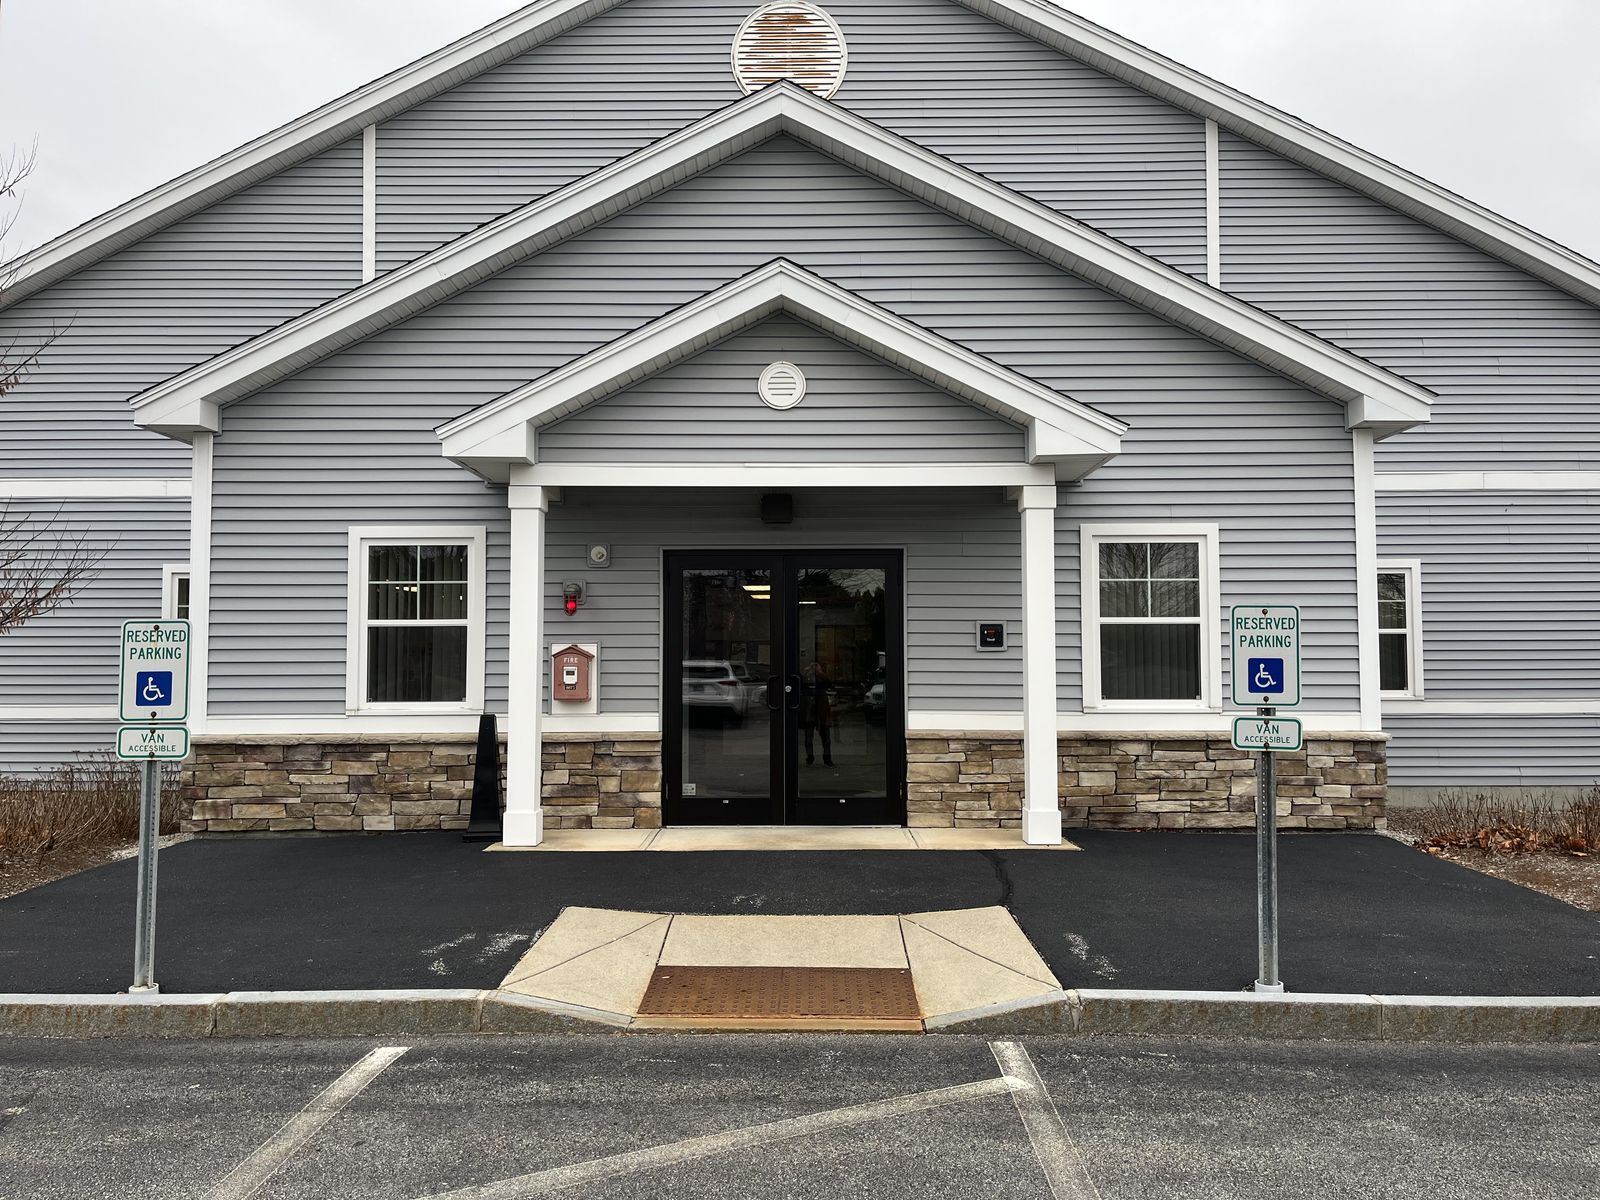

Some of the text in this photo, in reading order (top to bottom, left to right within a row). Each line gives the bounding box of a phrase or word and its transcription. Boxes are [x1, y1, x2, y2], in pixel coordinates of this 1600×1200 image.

[1236, 617, 1295, 630] RESERVED
[127, 630, 186, 643] RESERVED
[1240, 635, 1292, 648] PARKING
[130, 647, 182, 660] PARKING
[1256, 724, 1279, 734] VAN
[141, 733, 165, 743] VAN
[1244, 735, 1291, 744] ACCESSIBLE
